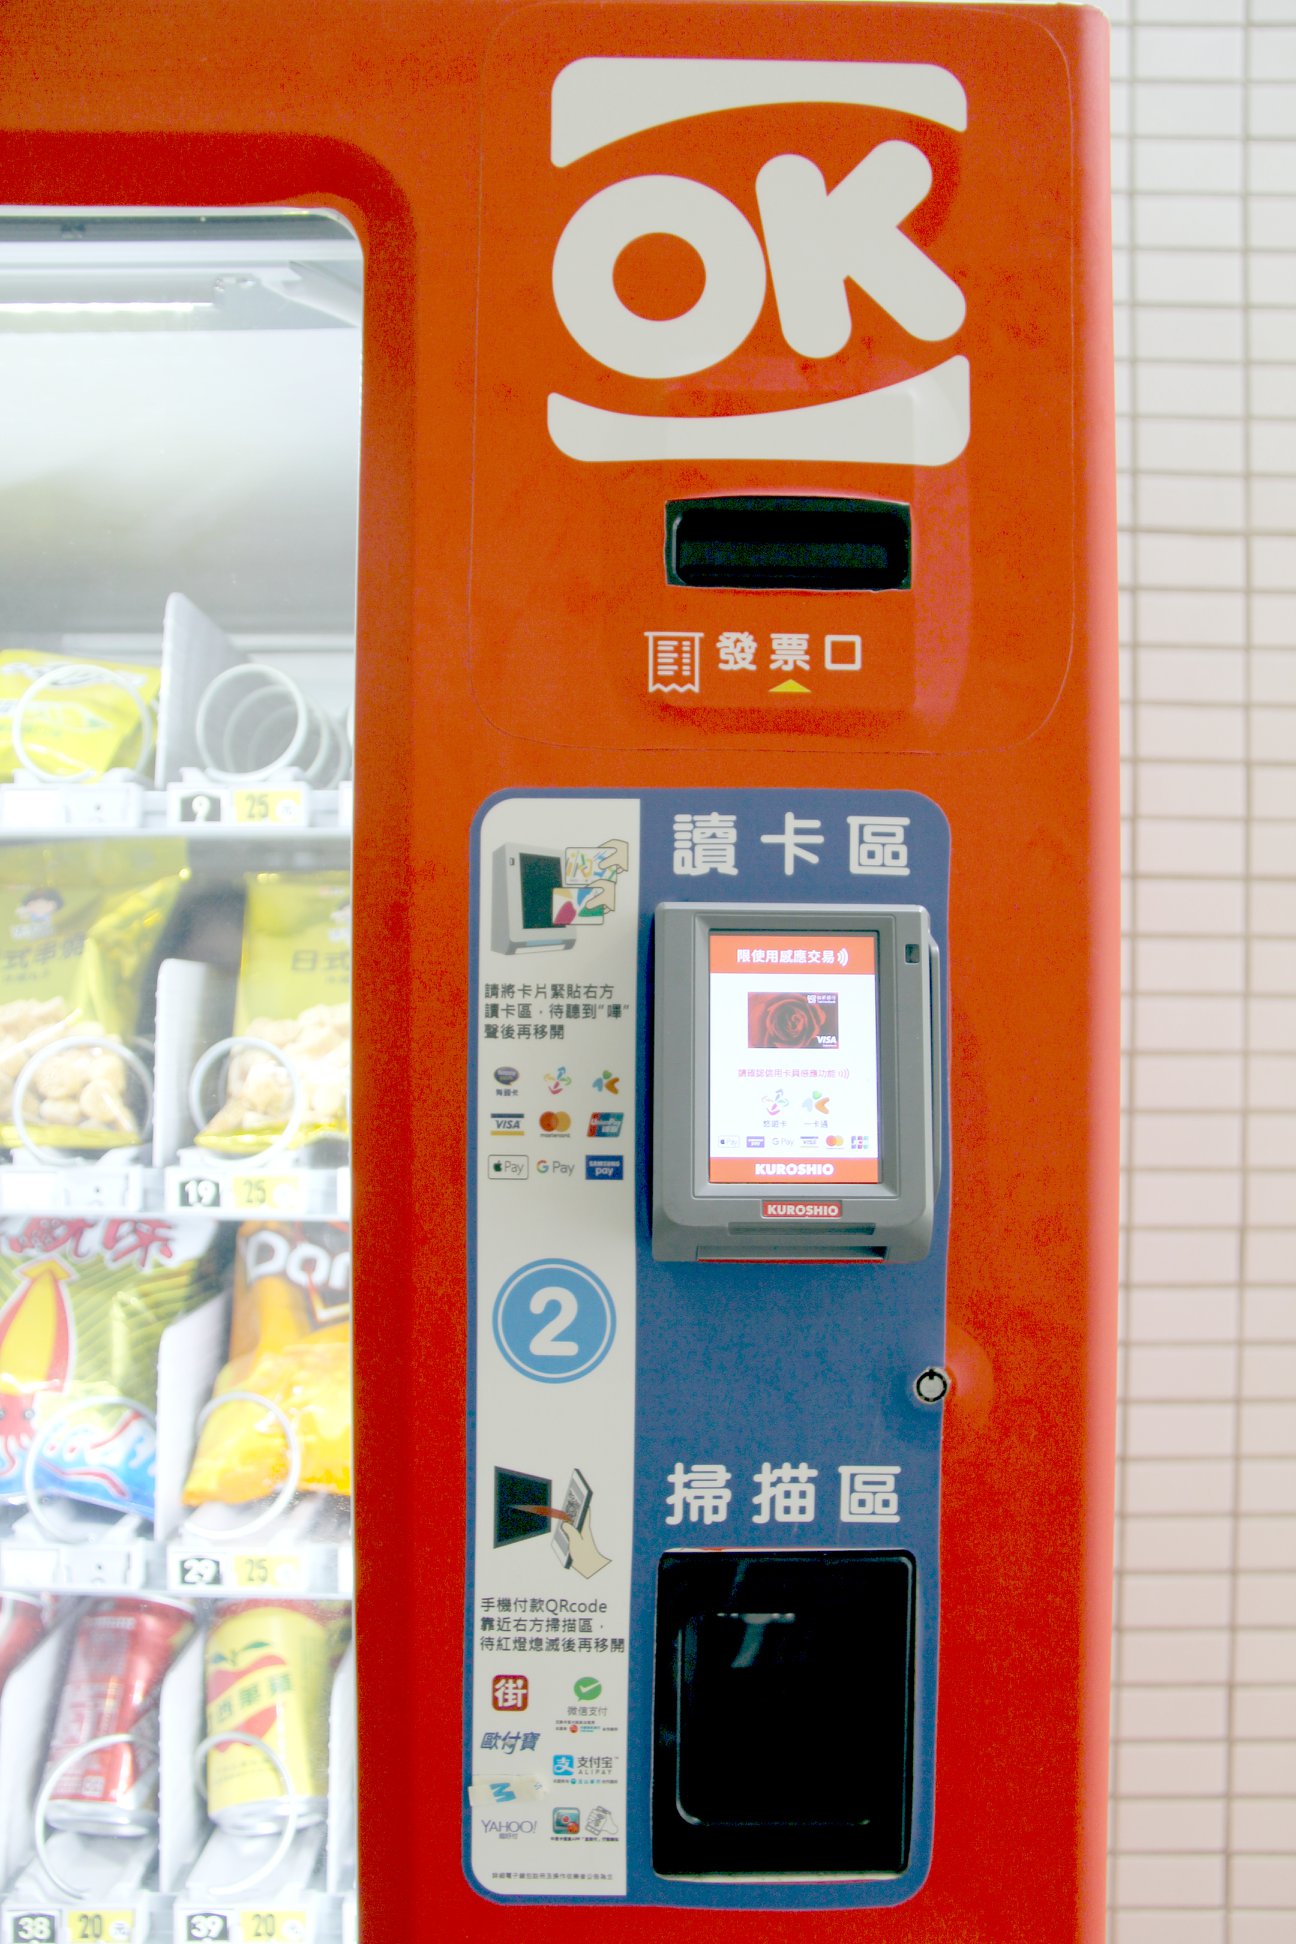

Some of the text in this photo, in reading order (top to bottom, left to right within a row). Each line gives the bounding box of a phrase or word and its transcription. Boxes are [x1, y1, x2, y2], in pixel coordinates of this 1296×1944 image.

[551, 139, 967, 379] OK
[717, 631, 862, 671] 發票口
[192, 795, 211, 822] 9
[246, 794, 268, 818] 25
[673, 812, 910, 876] 讀卡區
[737, 948, 835, 964] 限使用感應交易
[484, 983, 614, 999] 請將卡片緊貼右方
[484, 1024, 565, 1040] 聲後再移開
[816, 1036, 837, 1044] VISA
[495, 1120, 520, 1129] VISA
[504, 1161, 524, 1175] Pay
[552, 1161, 574, 1176] Pay
[596, 1167, 613, 1176] pay
[755, 1163, 834, 1175] KUROSHIO
[185, 1180, 217, 1206] 19
[244, 1180, 266, 1204] 25
[767, 1204, 839, 1217] KUROSHIO
[528, 1286, 578, 1356] 2
[665, 1462, 902, 1525] 掃描區
[184, 1558, 217, 1583] 29
[246, 1559, 268, 1582] 25
[481, 1597, 607, 1615] 手機付款QRcode
[481, 1637, 625, 1653] 待紅燈熄滅後再移開
[494, 1679, 527, 1708] 街
[568, 1706, 607, 1717] 微信支付
[480, 1731, 540, 1754] 歐付寶
[481, 1819, 537, 1834] YAHOO!
[17, 1916, 52, 1940] 38
[79, 1914, 102, 1939] 20
[190, 1916, 220, 1938] 39
[252, 1914, 275, 1937] 20
